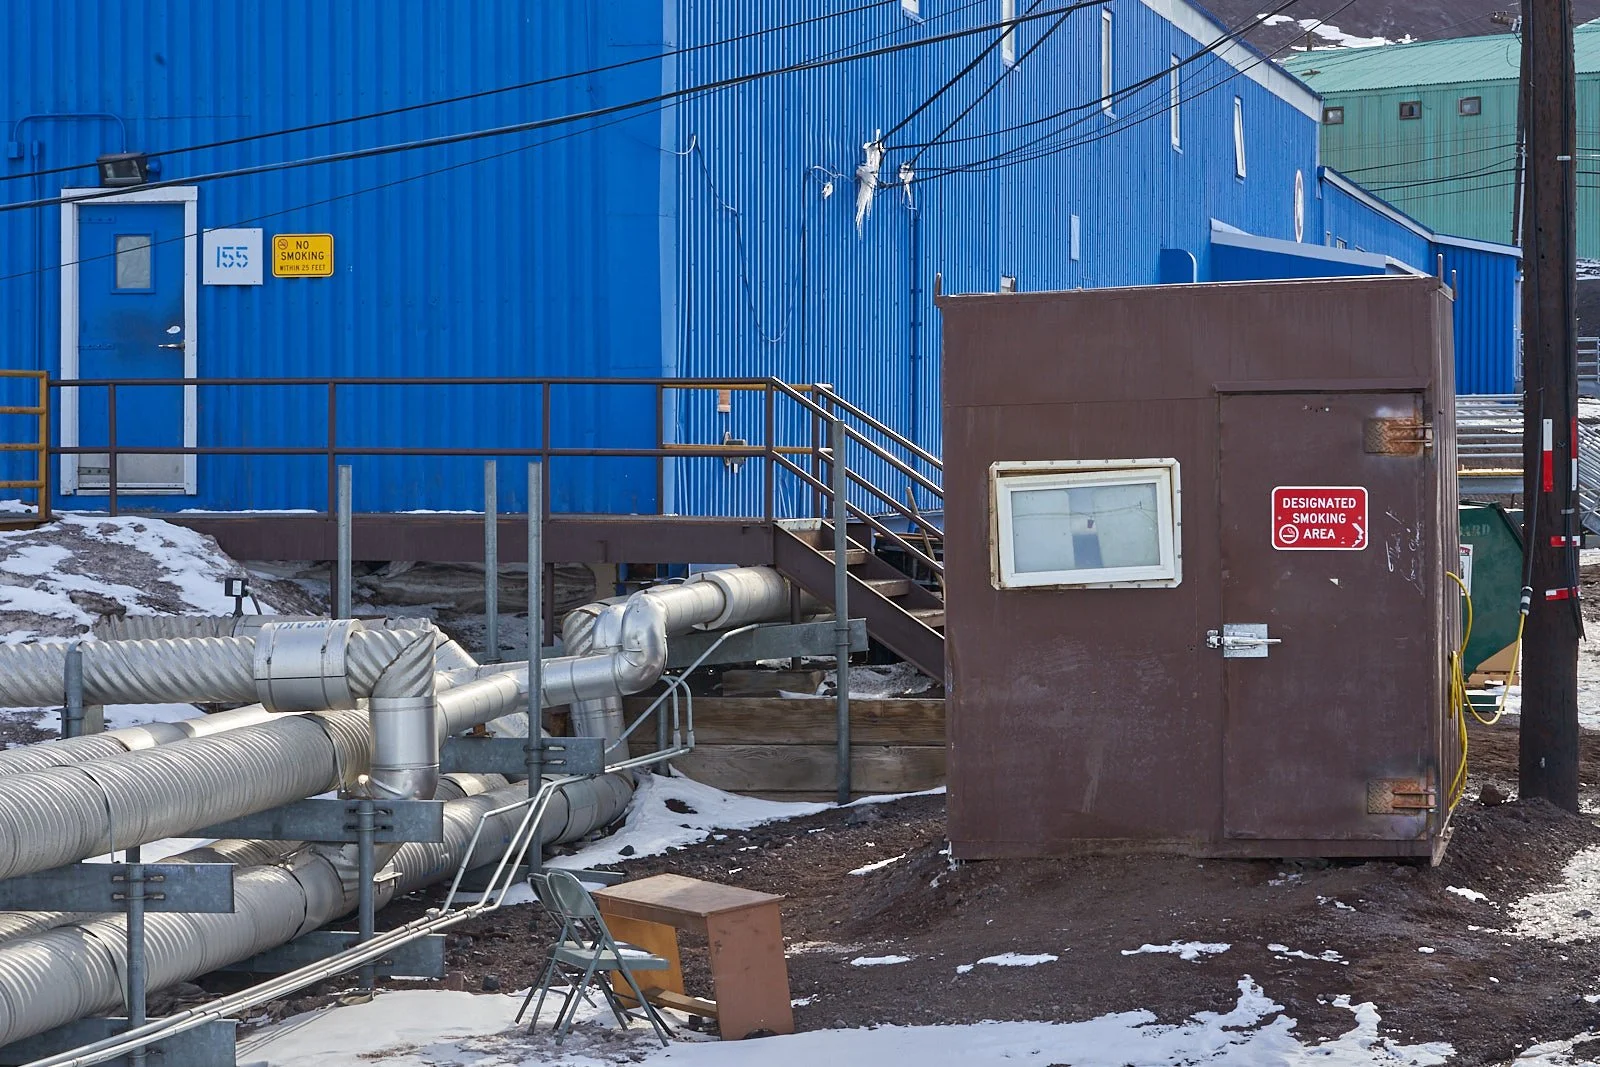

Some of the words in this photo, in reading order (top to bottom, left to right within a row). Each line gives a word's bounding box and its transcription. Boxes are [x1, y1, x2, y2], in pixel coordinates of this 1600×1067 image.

[295, 240, 310, 250] NO
[216, 246, 249, 268] 155
[280, 251, 325, 261] SMOKING
[1282, 497, 1357, 509] DESIGNATED
[1292, 513, 1347, 524] SMOKING
[1303, 528, 1336, 540] AREA
